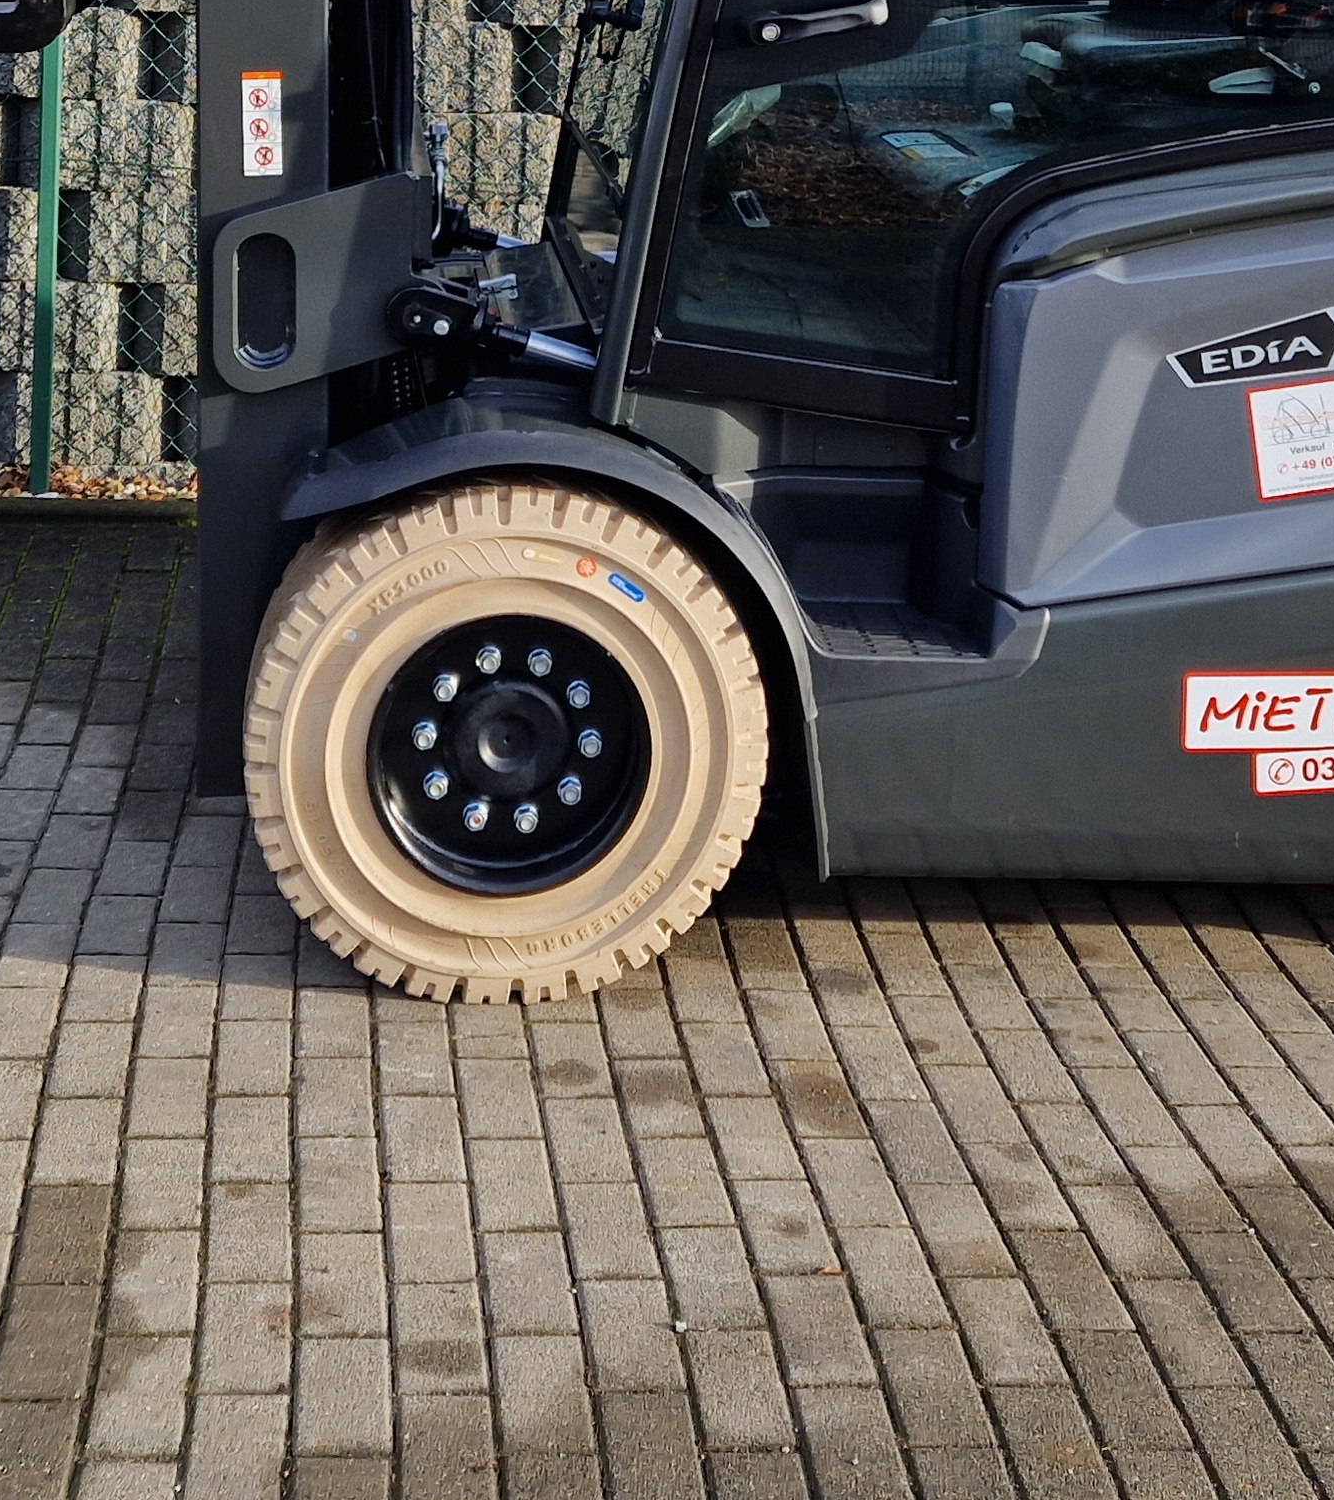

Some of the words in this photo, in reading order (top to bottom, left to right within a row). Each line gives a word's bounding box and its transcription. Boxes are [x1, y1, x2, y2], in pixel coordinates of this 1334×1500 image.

[1289, 442, 1325, 455] Verkauf
[1292, 459, 1316, 470] +49
[366, 559, 450, 617] XP1000
[525, 868, 671, 956] TRELLEBORG
